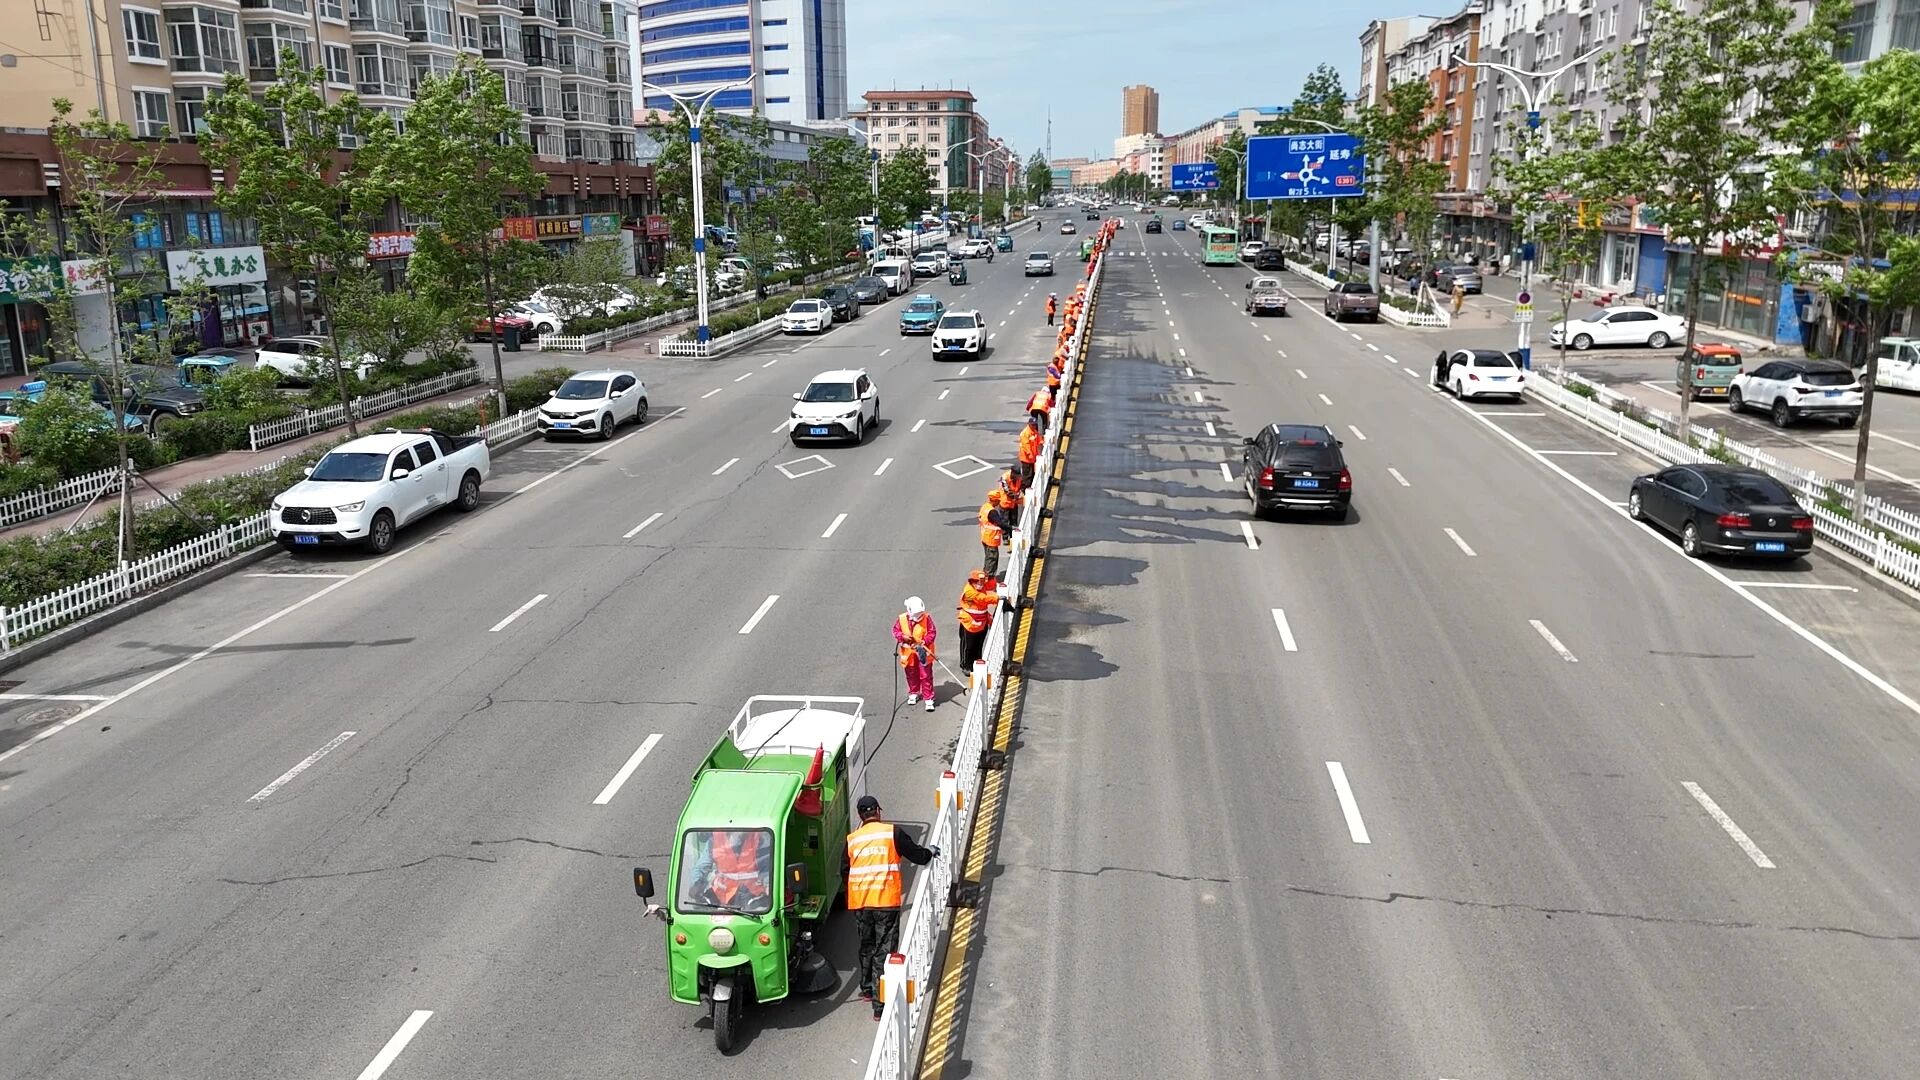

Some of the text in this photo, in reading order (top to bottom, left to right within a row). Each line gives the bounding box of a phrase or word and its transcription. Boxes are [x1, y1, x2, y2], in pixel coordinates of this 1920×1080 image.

[1290, 139, 1323, 151] 尚志大街
[1329, 149, 1351, 160] 延寿
